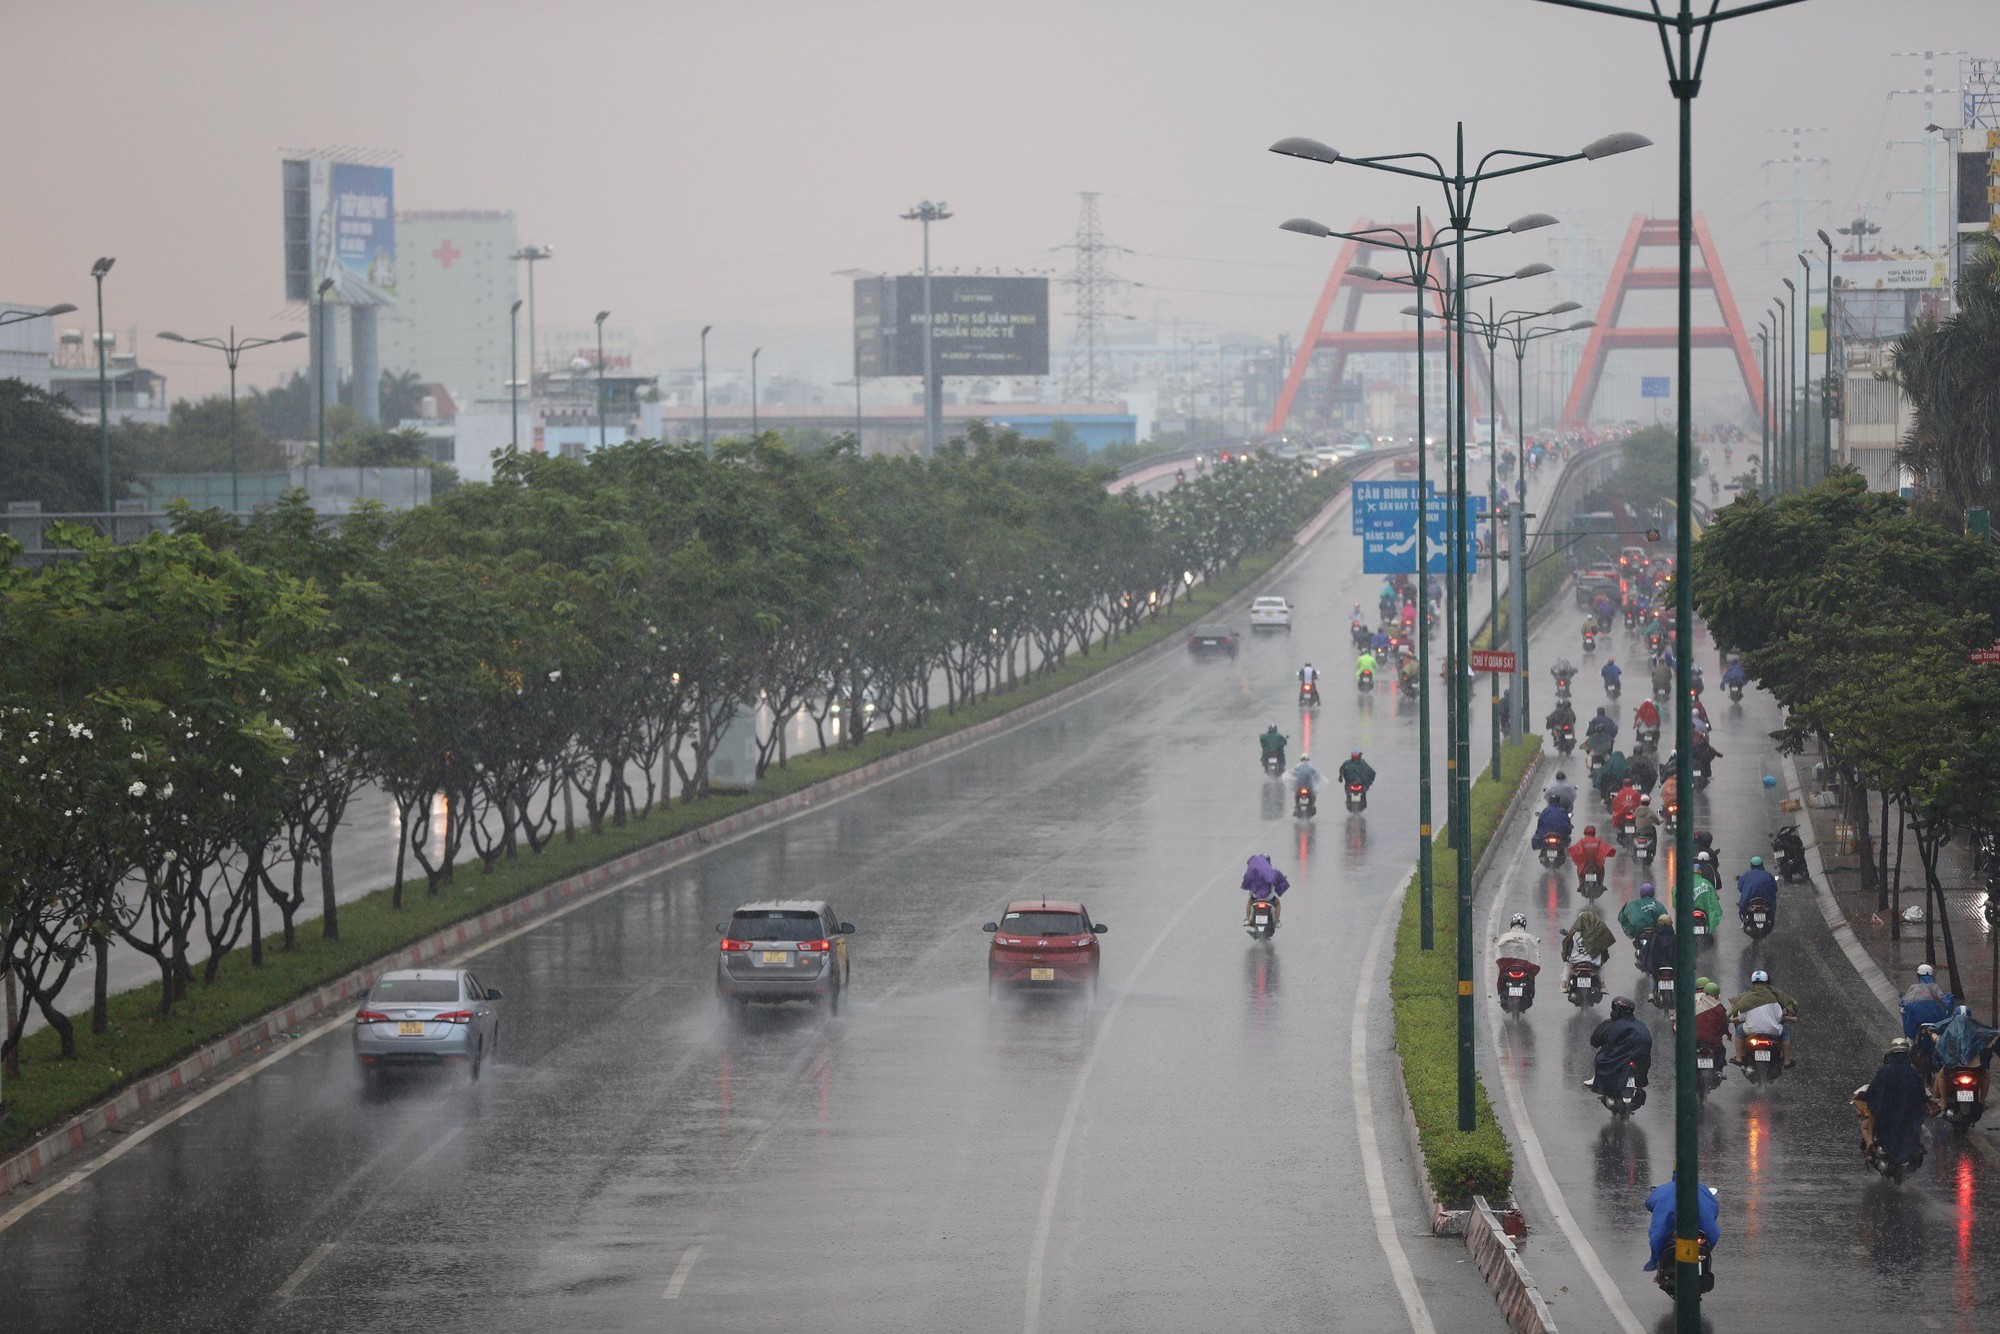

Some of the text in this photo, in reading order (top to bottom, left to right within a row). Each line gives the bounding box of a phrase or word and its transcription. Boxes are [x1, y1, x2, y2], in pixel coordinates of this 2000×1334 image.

[1384, 485, 1407, 499] BÌNH
[1366, 529, 1404, 540] HÀNG XANH
